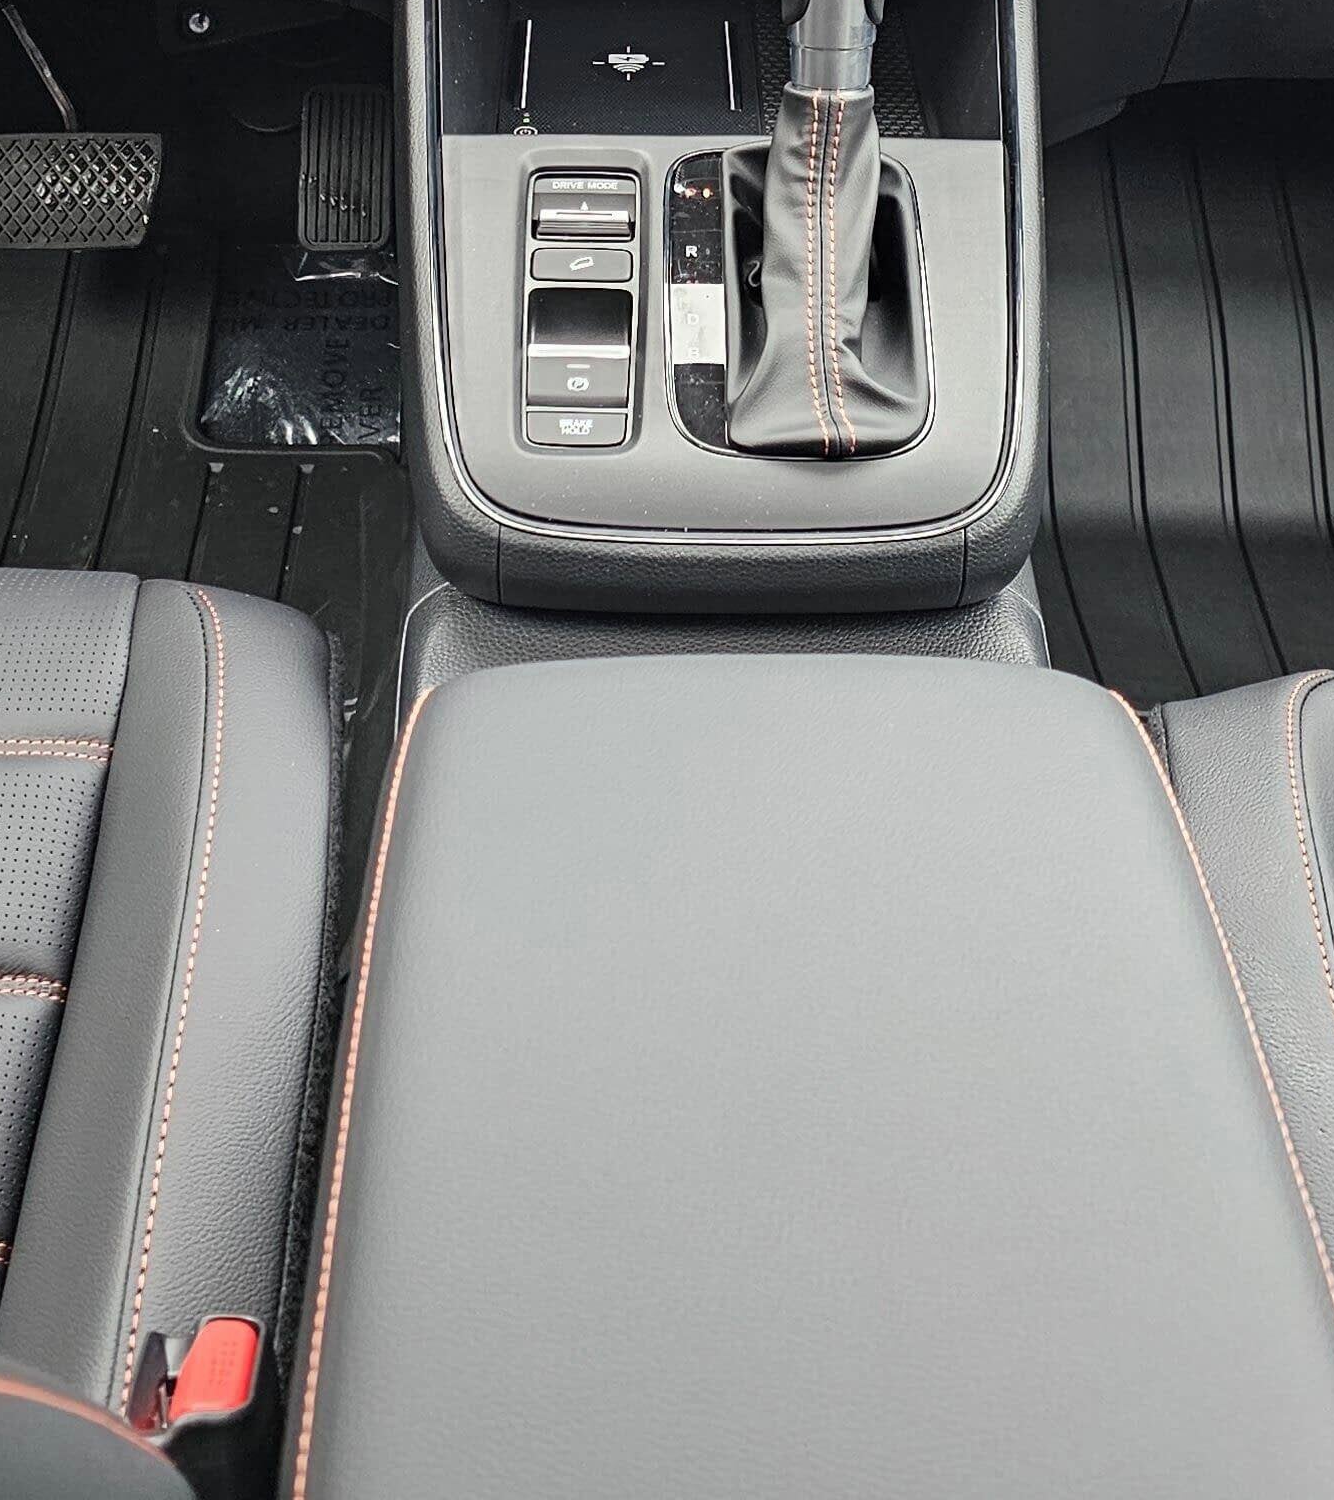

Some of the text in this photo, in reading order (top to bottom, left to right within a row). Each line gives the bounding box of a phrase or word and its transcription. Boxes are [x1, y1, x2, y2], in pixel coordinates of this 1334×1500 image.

[552, 181, 618, 190] DRIVE MODE
[685, 244, 698, 258] R
[561, 426, 591, 436] HOLD
